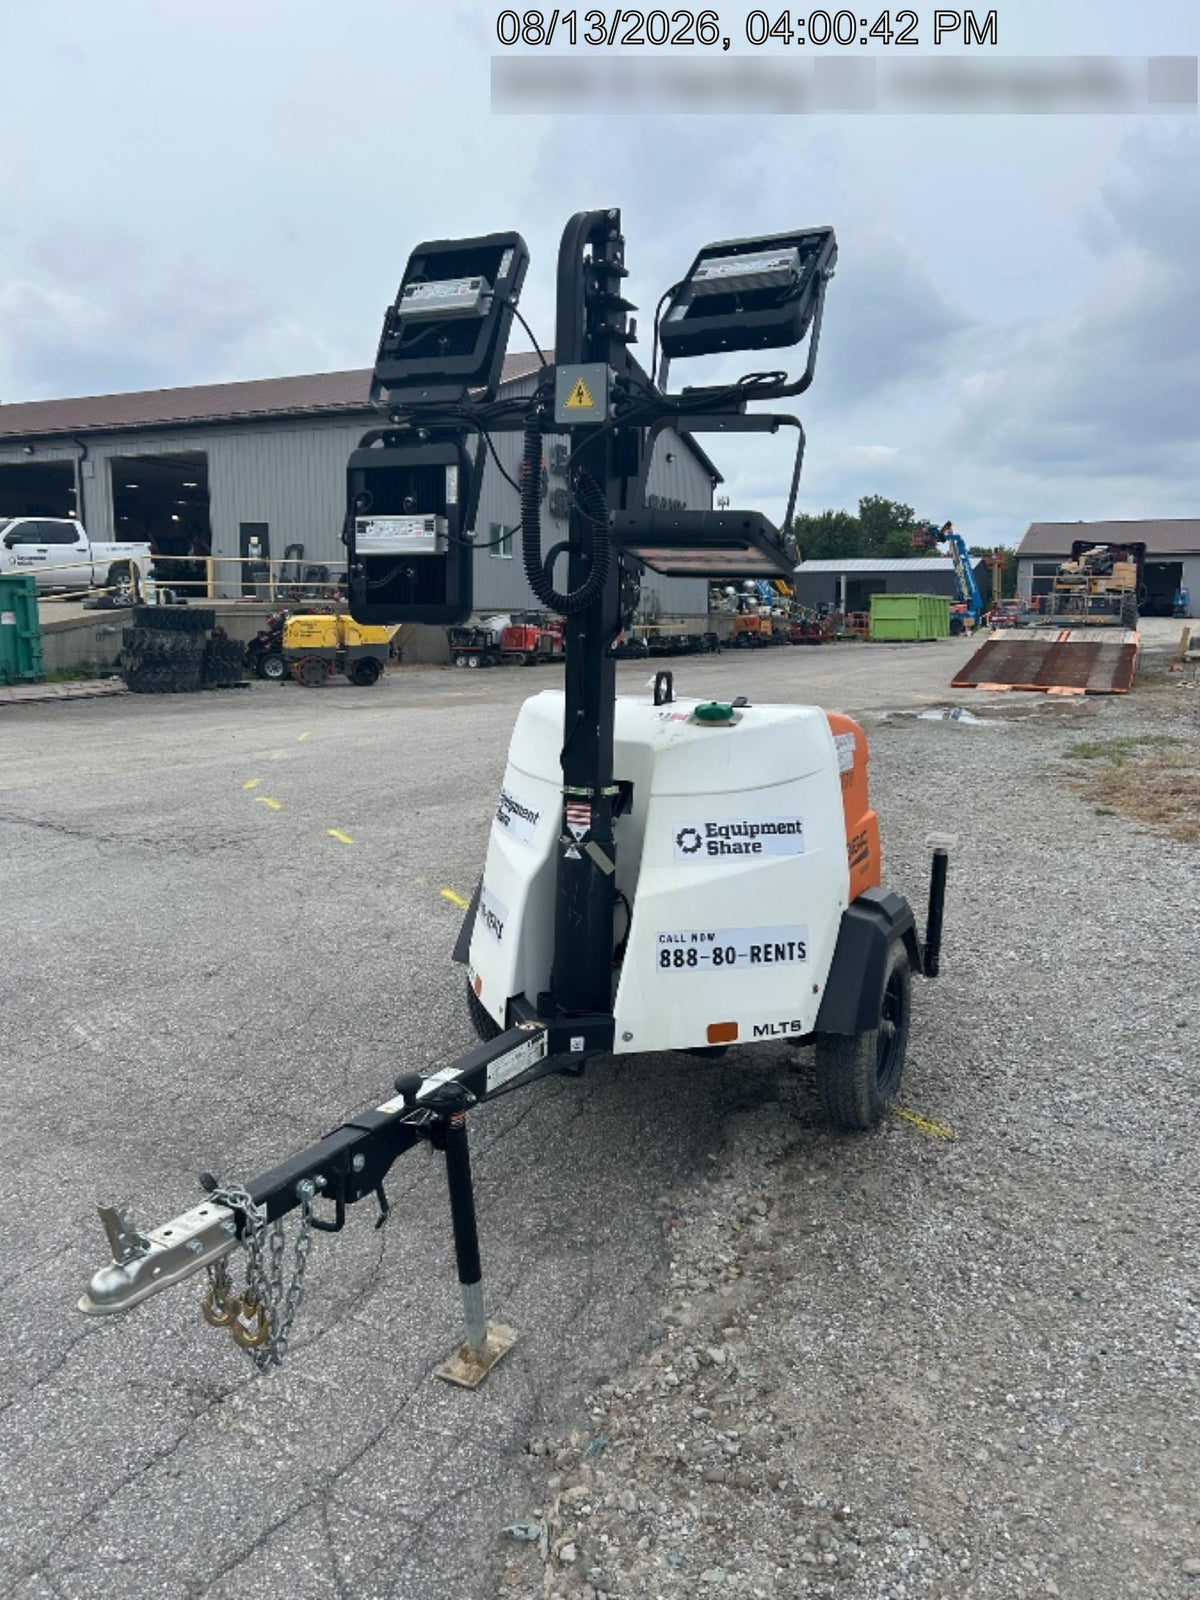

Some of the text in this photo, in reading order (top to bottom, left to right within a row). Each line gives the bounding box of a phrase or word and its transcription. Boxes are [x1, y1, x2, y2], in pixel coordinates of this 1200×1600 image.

[704, 820, 803, 840] Equipment
[706, 840, 763, 856] Share
[658, 932, 716, 944] CALL NOW
[659, 941, 807, 968] 888-80-RENTS
